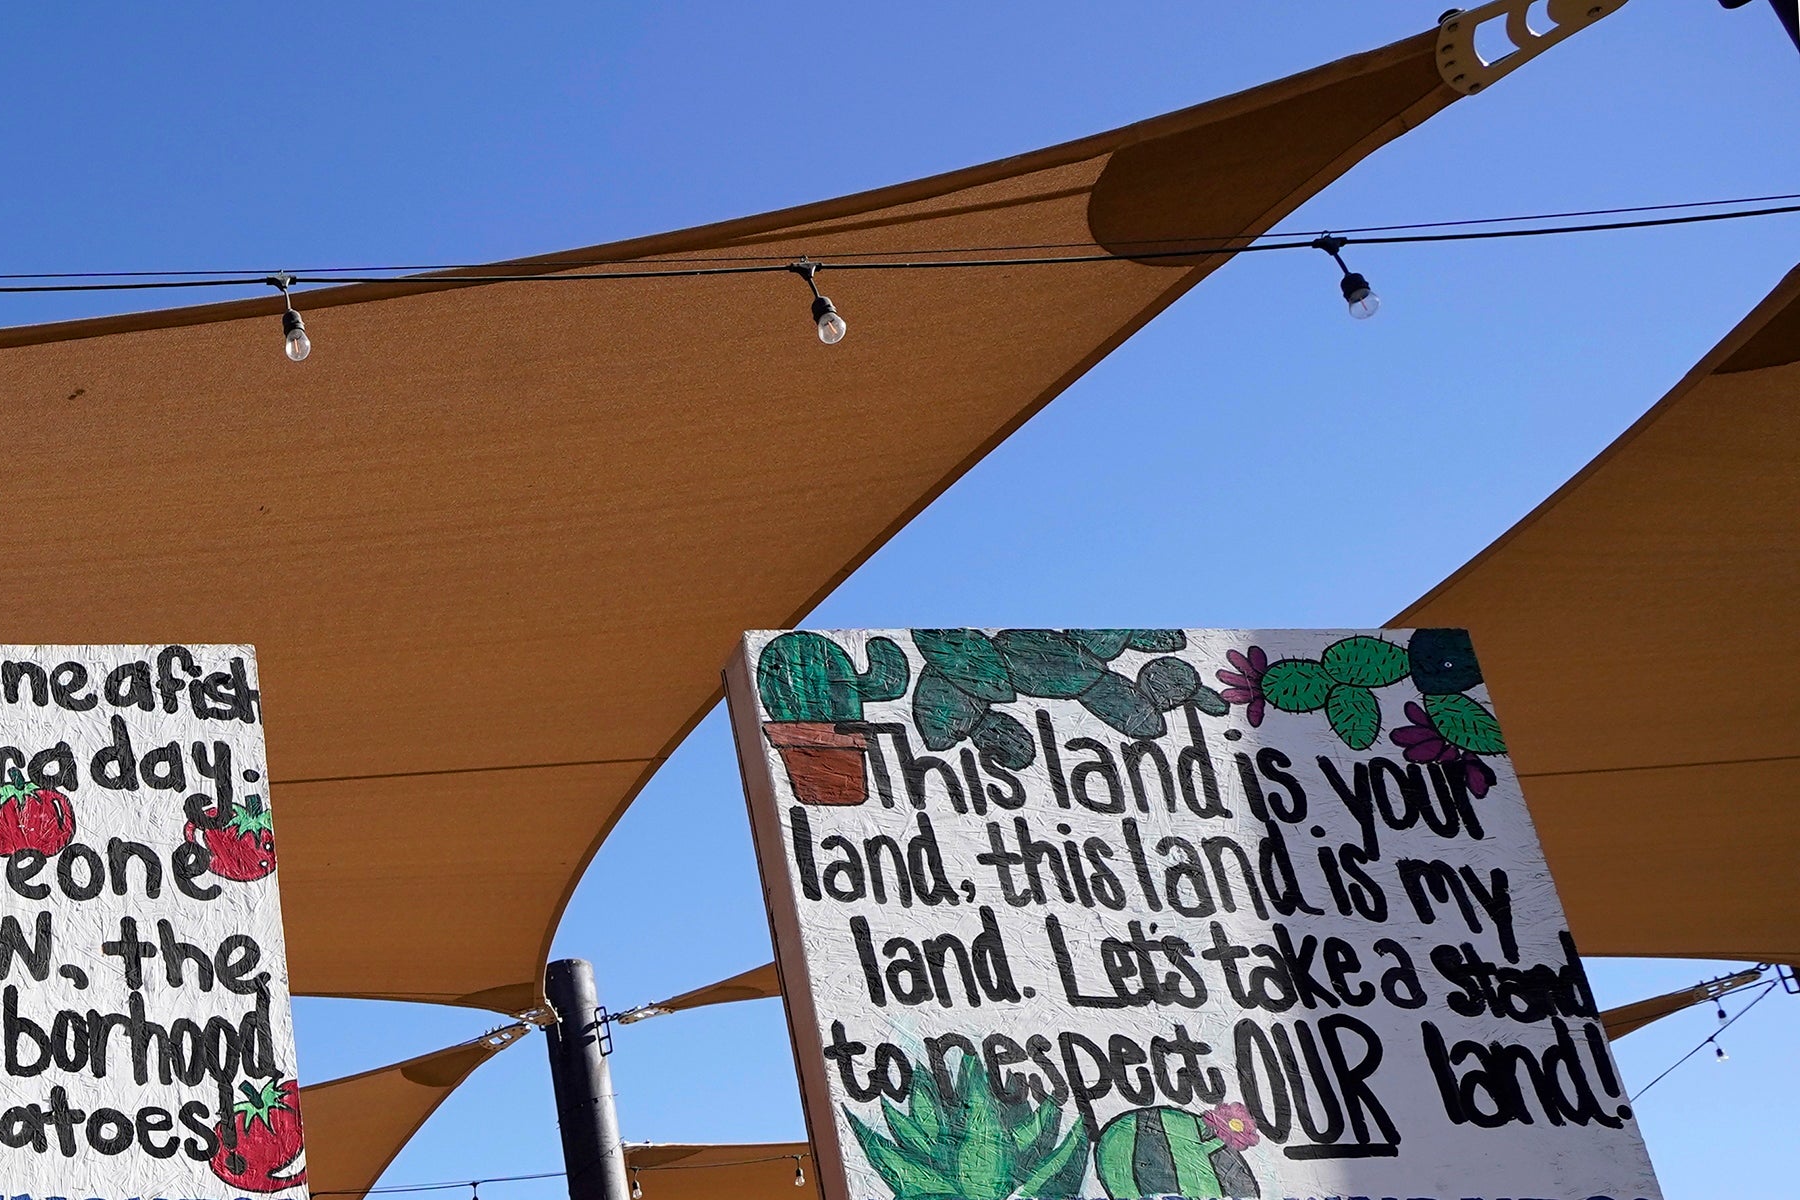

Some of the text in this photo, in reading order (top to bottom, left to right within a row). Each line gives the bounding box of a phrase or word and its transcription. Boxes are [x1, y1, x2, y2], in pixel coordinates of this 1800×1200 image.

[104, 661, 159, 714] a
[158, 646, 264, 725] fish
[26, 746, 78, 790] a
[90, 716, 260, 826] day.
[835, 705, 1497, 860] This land is your
[791, 805, 1520, 961] land, this land is my
[103, 918, 268, 996] the
[850, 906, 1035, 1007] land.
[1201, 920, 1376, 1012] take
[1374, 937, 1427, 1010] a
[1430, 930, 1602, 1023] stand
[823, 1015, 1632, 1146] to respect OUR land!
